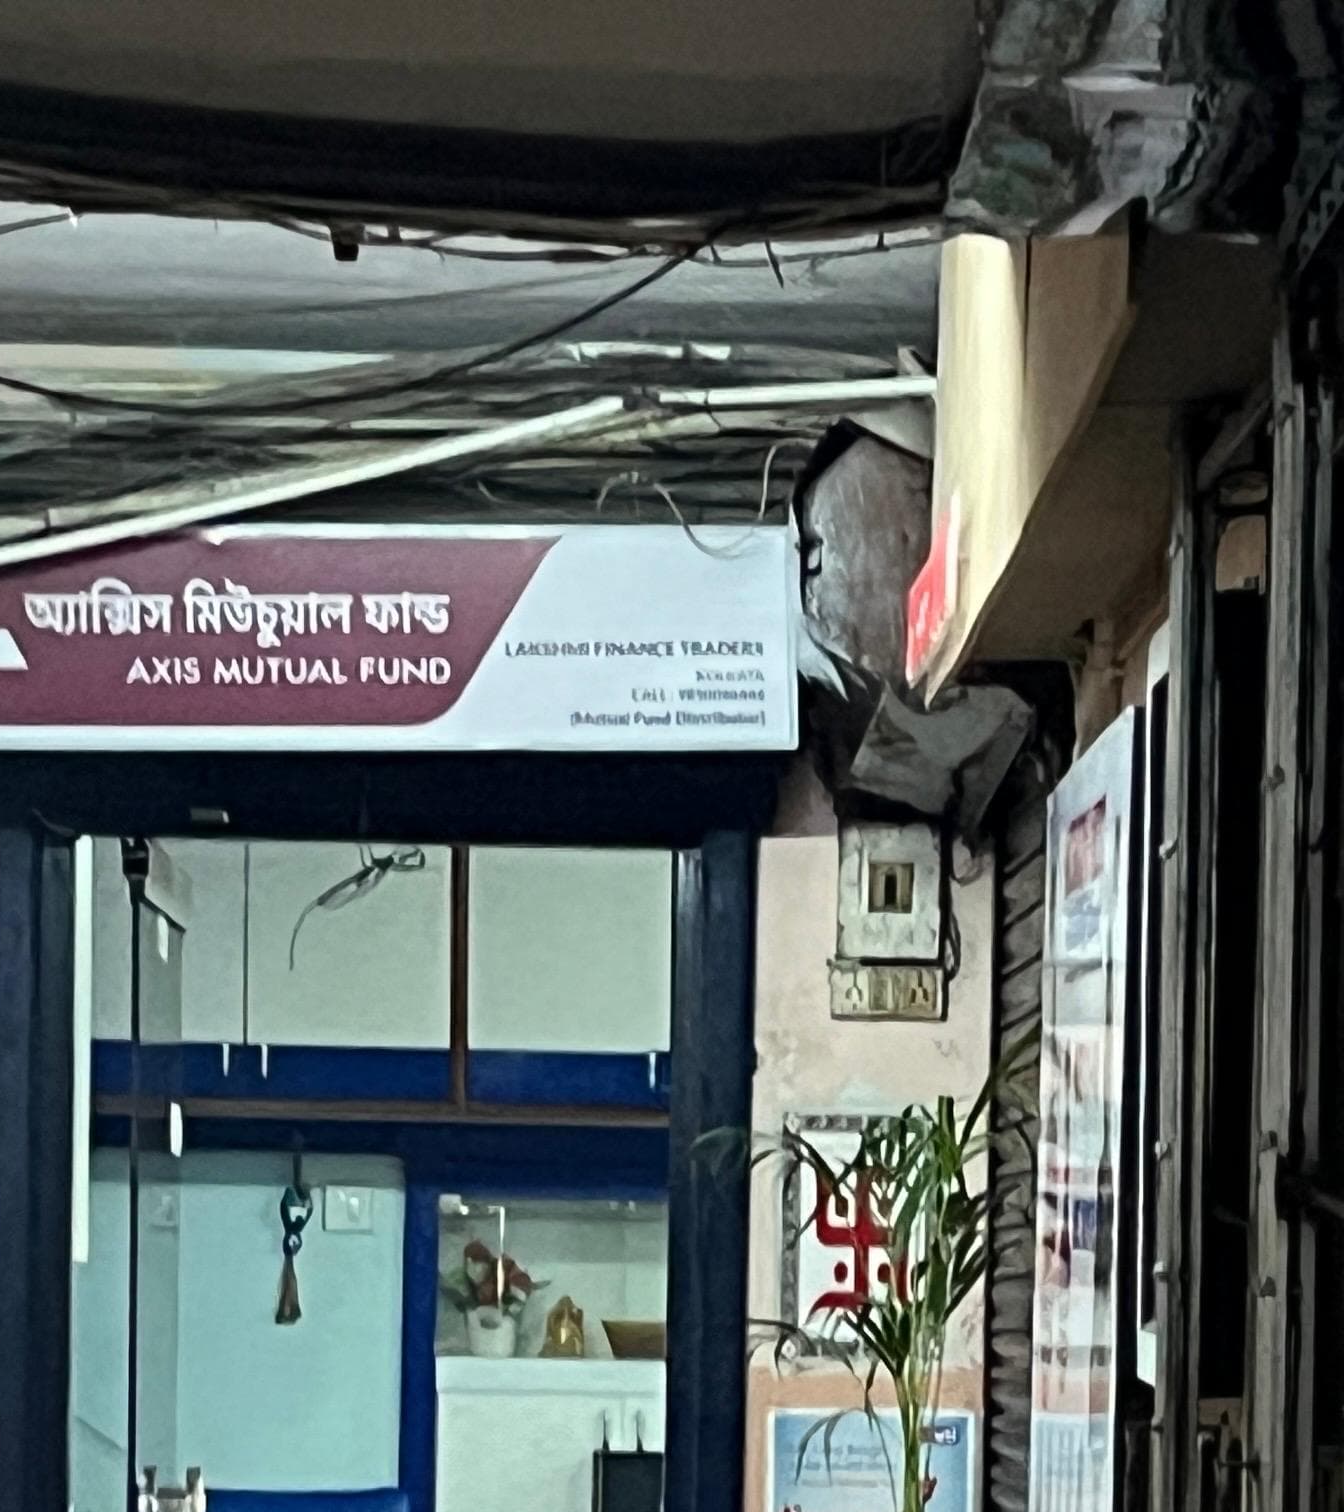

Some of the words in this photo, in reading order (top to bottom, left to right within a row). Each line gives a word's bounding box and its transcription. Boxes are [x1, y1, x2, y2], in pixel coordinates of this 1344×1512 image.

[126, 656, 202, 685] AXIS
[213, 656, 348, 685] MUTUAL
[360, 656, 451, 685] FUND
